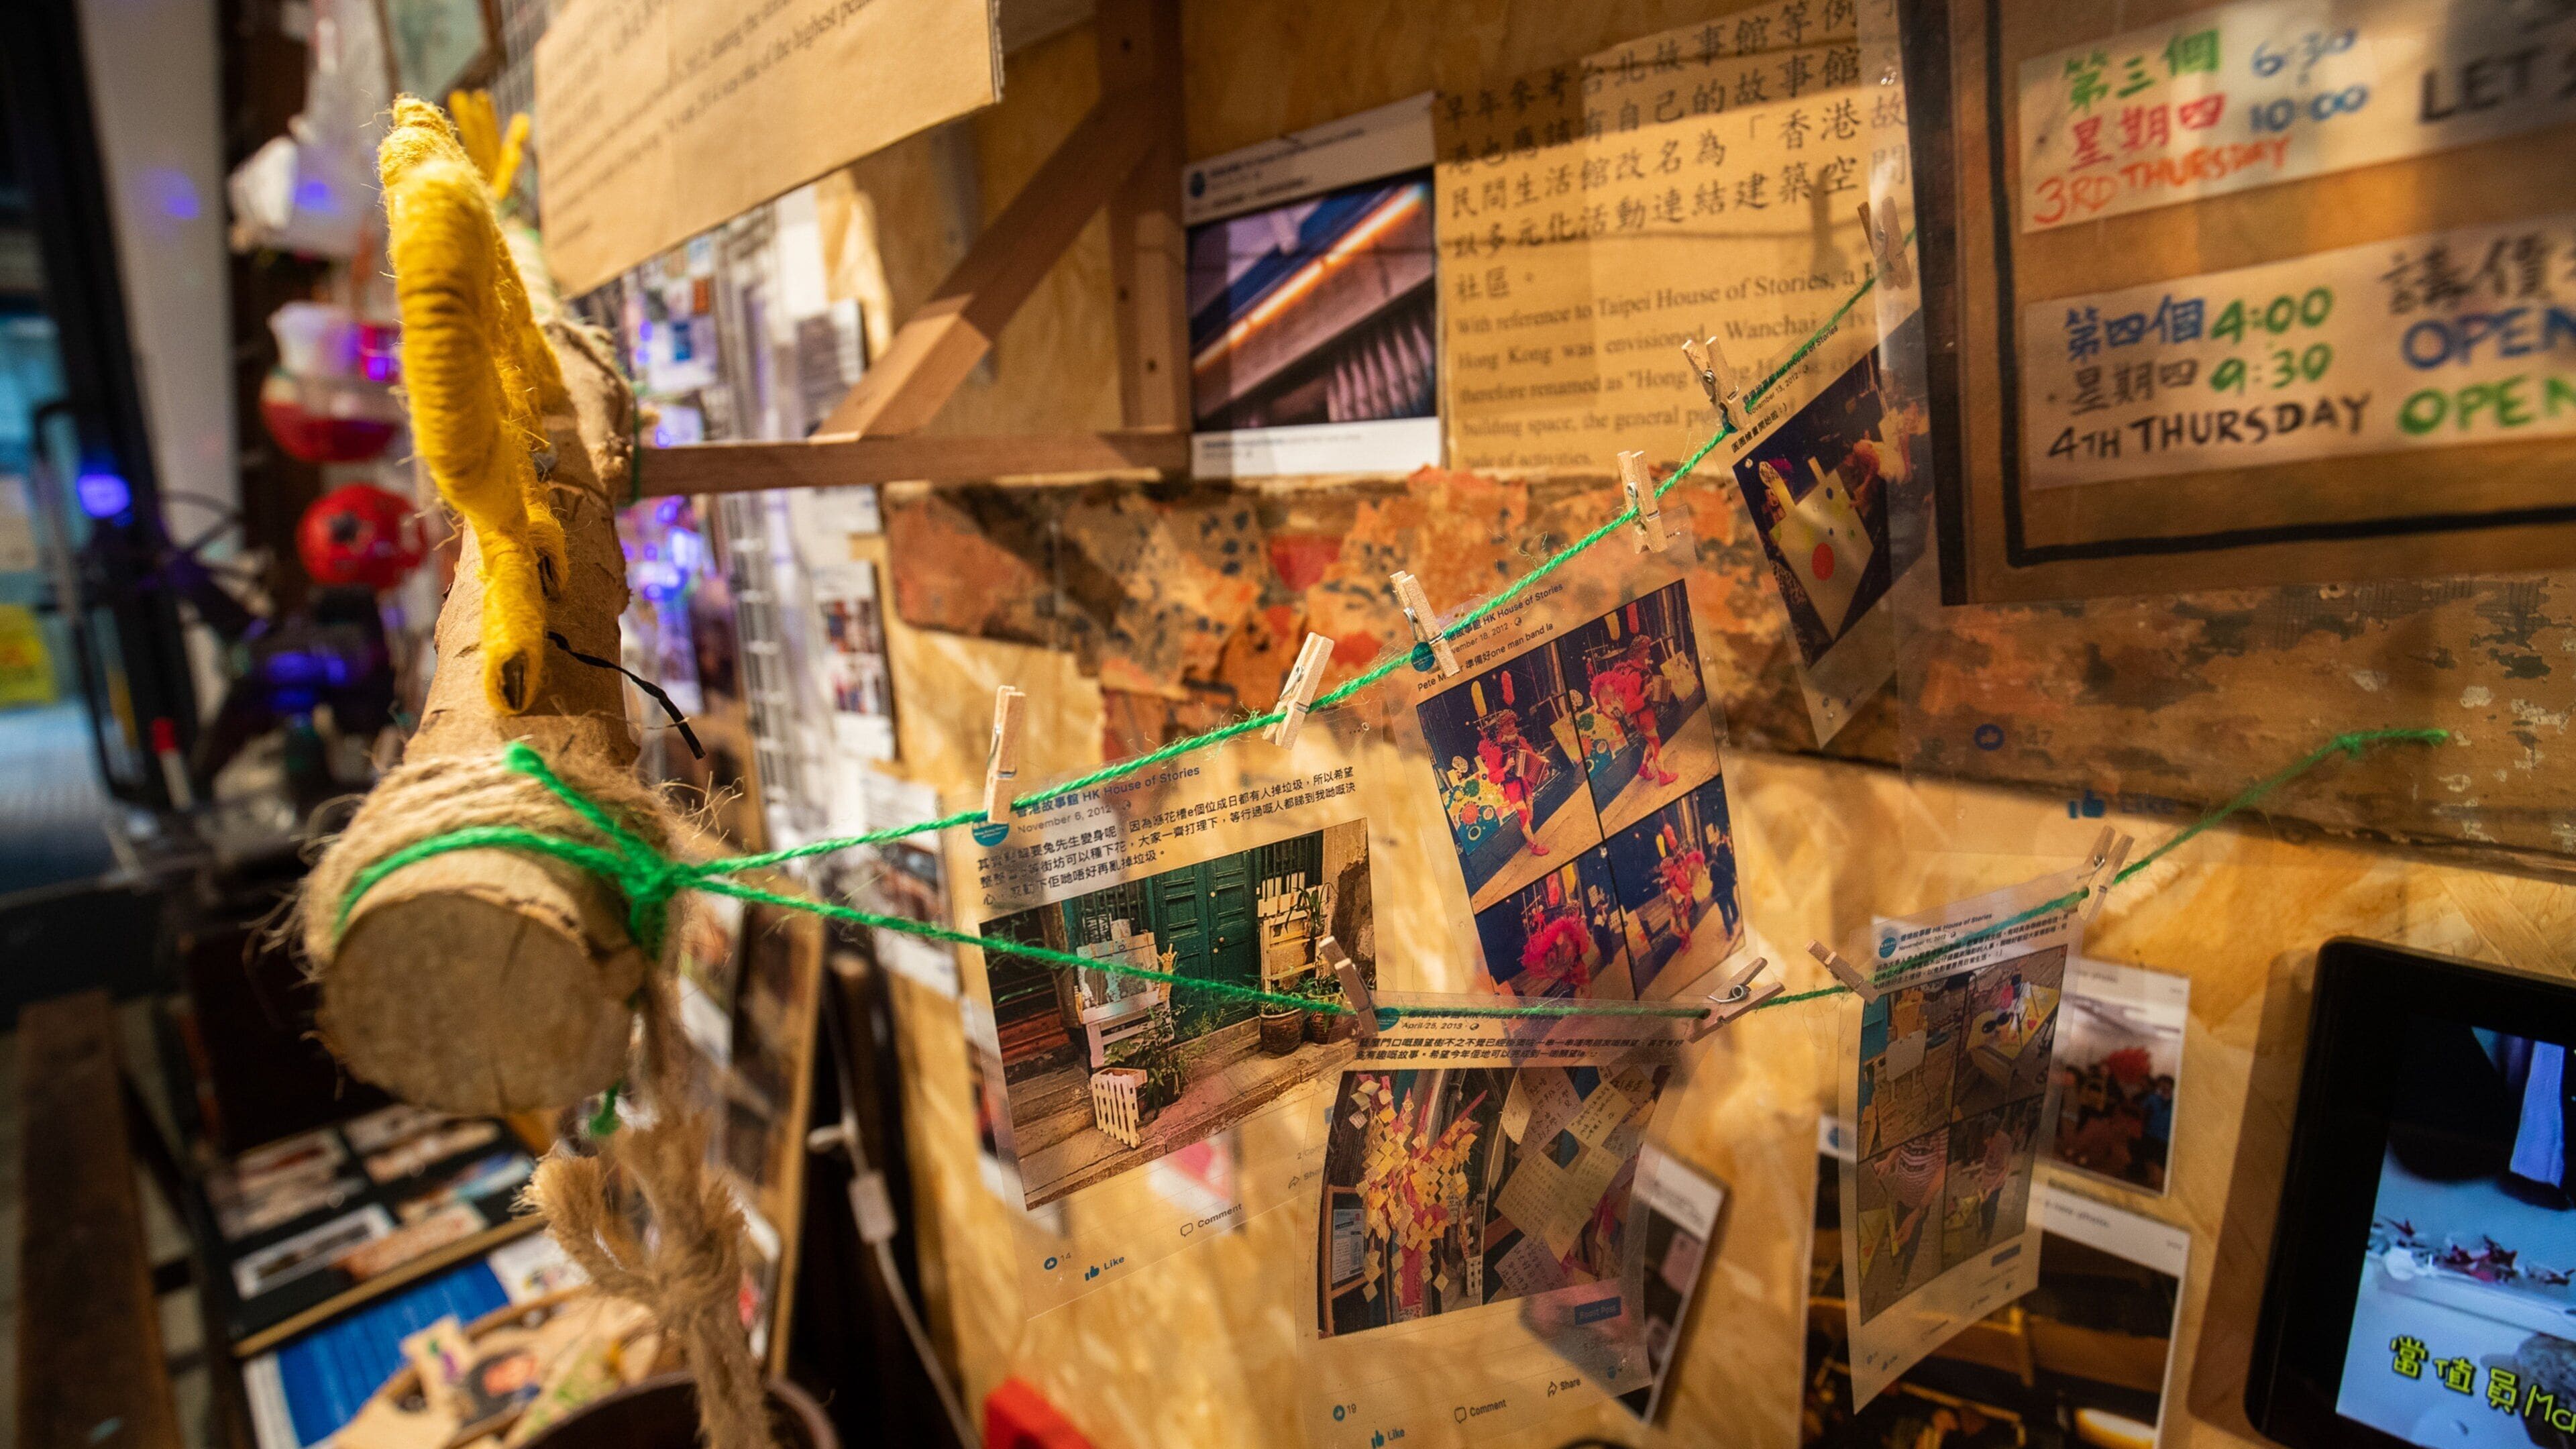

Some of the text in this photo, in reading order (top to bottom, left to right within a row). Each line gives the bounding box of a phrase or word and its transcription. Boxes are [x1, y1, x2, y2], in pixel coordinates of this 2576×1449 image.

[2063, 29, 2219, 113] 第三個
[2070, 93, 2226, 171] 星期四
[2033, 138, 2291, 223] 3RD THURSDAY
[1575, 305, 1593, 320] to
[1599, 297, 1651, 319] Taipei
[1656, 284, 1720, 309] House
[1725, 277, 1749, 300] of
[2065, 294, 2205, 362] 第四個
[2210, 287, 2334, 345] 4:00
[1458, 353, 1499, 371] Hong
[1507, 346, 1552, 367] Kong
[1561, 341, 1595, 359] was
[1787, 349, 1808, 370] House
[1815, 325, 1839, 347] Stories
[1606, 376, 1623, 392] as
[1785, 372, 1799, 388] 2012
[2209, 343, 2333, 395] 9:30
[2071, 359, 2199, 415] 星期四
[1581, 412, 1609, 430] the
[1614, 405, 1679, 432] general
[2047, 391, 2372, 459] 4TH THURSDAY
[1483, 612, 1496, 626] HK
[1497, 602, 1524, 621] House
[1524, 595, 1534, 606] of
[1534, 583, 1564, 602] Stories
[1451, 637, 1479, 655] vember
[1491, 623, 1509, 637] 2012
[1507, 637, 1525, 650] man
[1524, 626, 1546, 642] band
[1417, 677, 1437, 692] Pete
[1082, 790, 1101, 802] HK
[1104, 780, 1142, 797] House
[1144, 774, 1157, 787] of
[1159, 765, 1201, 785] Stories
[1017, 814, 1072, 835] November
[1087, 804, 1113, 818] 2012
[1943, 920, 1962, 930] House
[1971, 914, 1993, 924] Stories
[1401, 1022, 1423, 1031] April
[1440, 1022, 1463, 1030] 2013
[1197, 1203, 1243, 1229] Comment
[1060, 1252, 1126, 1272] 14 Like
[1559, 1377, 1581, 1393] Share
[1469, 1397, 1507, 1418] Comment
[1387, 1427, 1406, 1442] Like
